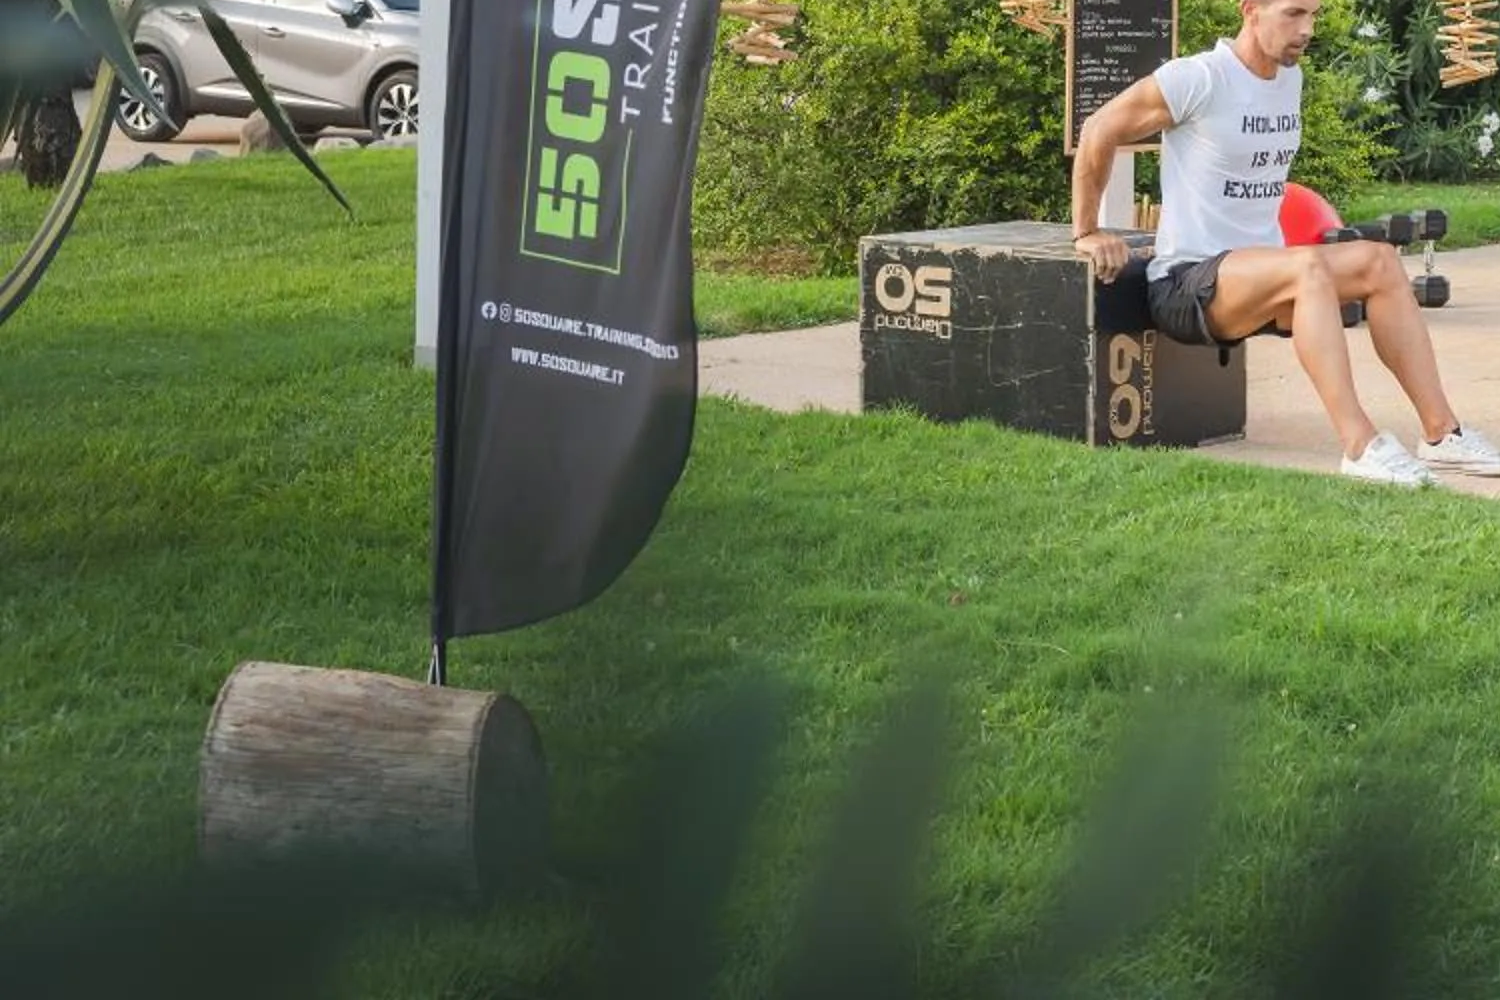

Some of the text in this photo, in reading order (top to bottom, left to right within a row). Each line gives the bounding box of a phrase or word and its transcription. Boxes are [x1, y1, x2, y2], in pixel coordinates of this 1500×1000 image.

[1250, 151, 1269, 168] IS
[1223, 180, 1284, 199] EXCUS
[875, 263, 952, 318] 50
[874, 313, 952, 339] Diamond
[1143, 329, 1157, 435] Diamond
